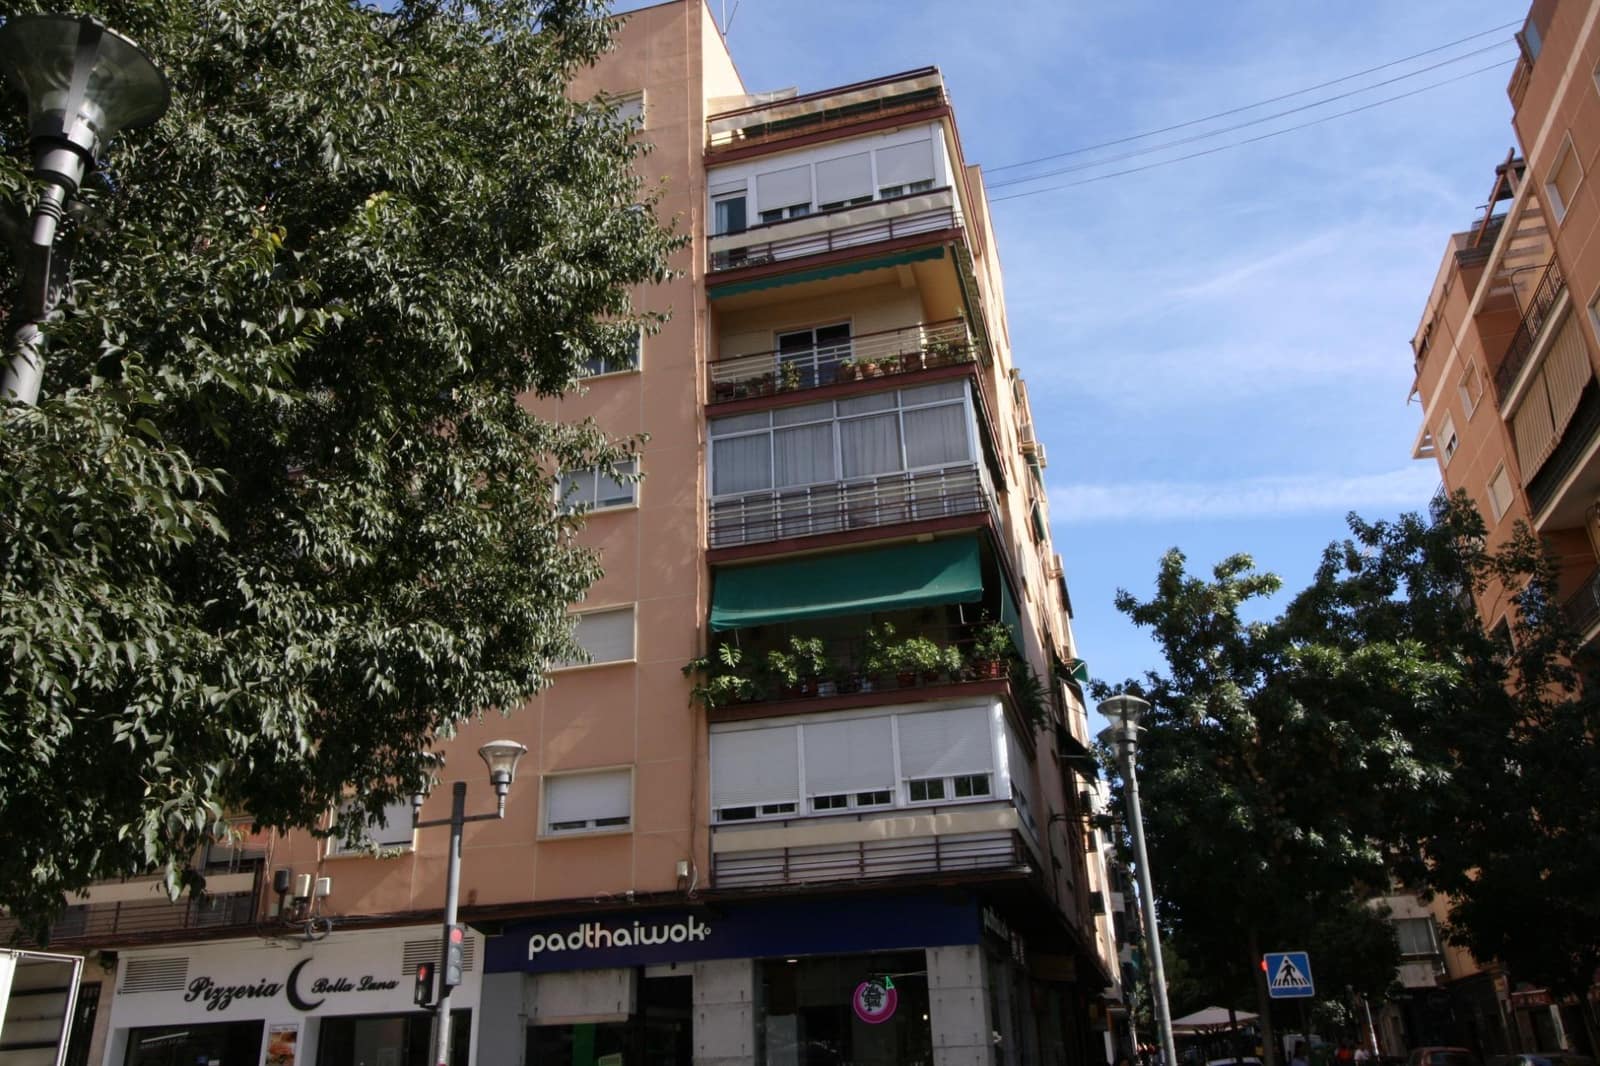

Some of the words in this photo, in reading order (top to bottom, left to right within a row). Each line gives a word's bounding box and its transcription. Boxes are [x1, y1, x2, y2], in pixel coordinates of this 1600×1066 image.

[528, 915, 706, 961] padthaiwok
[184, 976, 284, 1011] Pizzeria
[311, 977, 354, 994] Bella
[356, 975, 400, 992] Luna
